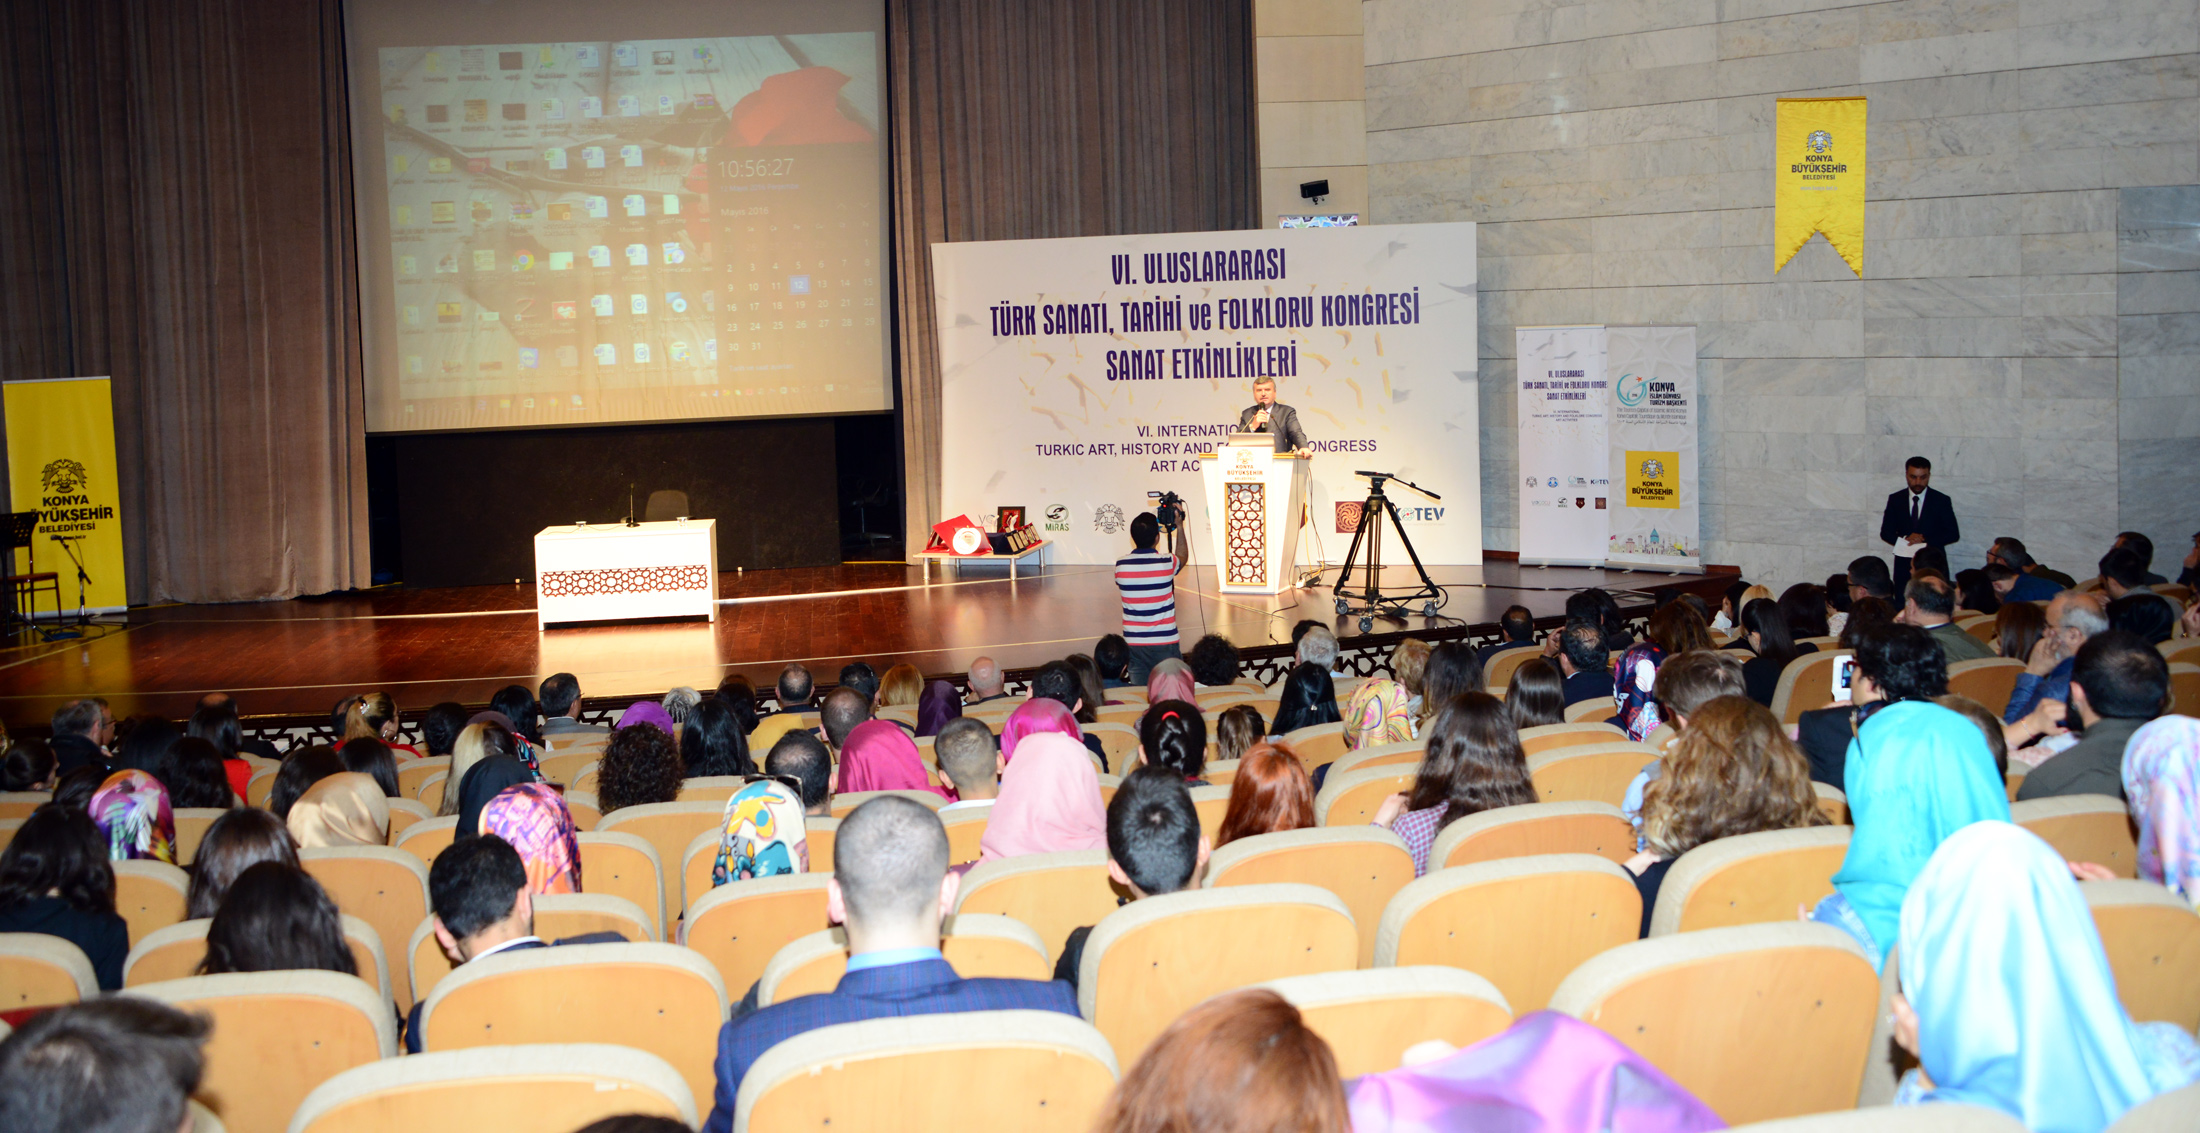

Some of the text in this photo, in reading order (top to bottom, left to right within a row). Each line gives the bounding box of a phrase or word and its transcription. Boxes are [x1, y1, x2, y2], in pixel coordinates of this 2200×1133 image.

[718, 158, 794, 178] 10:56:27
[1791, 163, 1847, 174] BÜYÜKŞEHİR
[721, 206, 769, 218] Mayıs 2016
[1111, 248, 1286, 285] VI. ULUSLARARASI
[749, 283, 759, 291] 10
[772, 282, 781, 290] 11
[794, 281, 804, 289] 12
[818, 280, 827, 288] 13
[840, 279, 850, 287] 14
[864, 278, 873, 286] 15
[727, 304, 737, 312] 16
[750, 302, 759, 310] 17
[773, 302, 782, 310] 18
[818, 300, 828, 308] 20
[841, 299, 850, 307] 21
[864, 298, 874, 306] 22
[990, 286, 1420, 336] TÜRK SANATI, TARİHİ ve FOLKLORU KONGRESİ
[727, 324, 737, 332] 23
[751, 322, 760, 330] 24
[796, 320, 806, 328] 26
[819, 320, 829, 328] 27
[842, 319, 852, 327] 28
[865, 318, 875, 326] 29
[728, 342, 761, 351] 30 31
[1106, 340, 1297, 381] SANAT ETKİNLİKLERİ
[1649, 382, 1675, 392] KONYA
[1137, 424, 1239, 437] VI. INTERNATIO
[1035, 444, 1085, 456] TURKIC
[1088, 444, 1117, 457] ART,
[1121, 443, 1180, 455] HISTORY
[1183, 443, 1213, 454] AND
[1308, 440, 1377, 452] ONGRESS
[1150, 461, 1177, 472] ART
[1632, 486, 1673, 495] BÜYÜKŞEHİR
[42, 495, 89, 507] KONYA
[31, 505, 113, 523] YÜKŞEHİR
[39, 521, 95, 533] BELEDİYESİ
